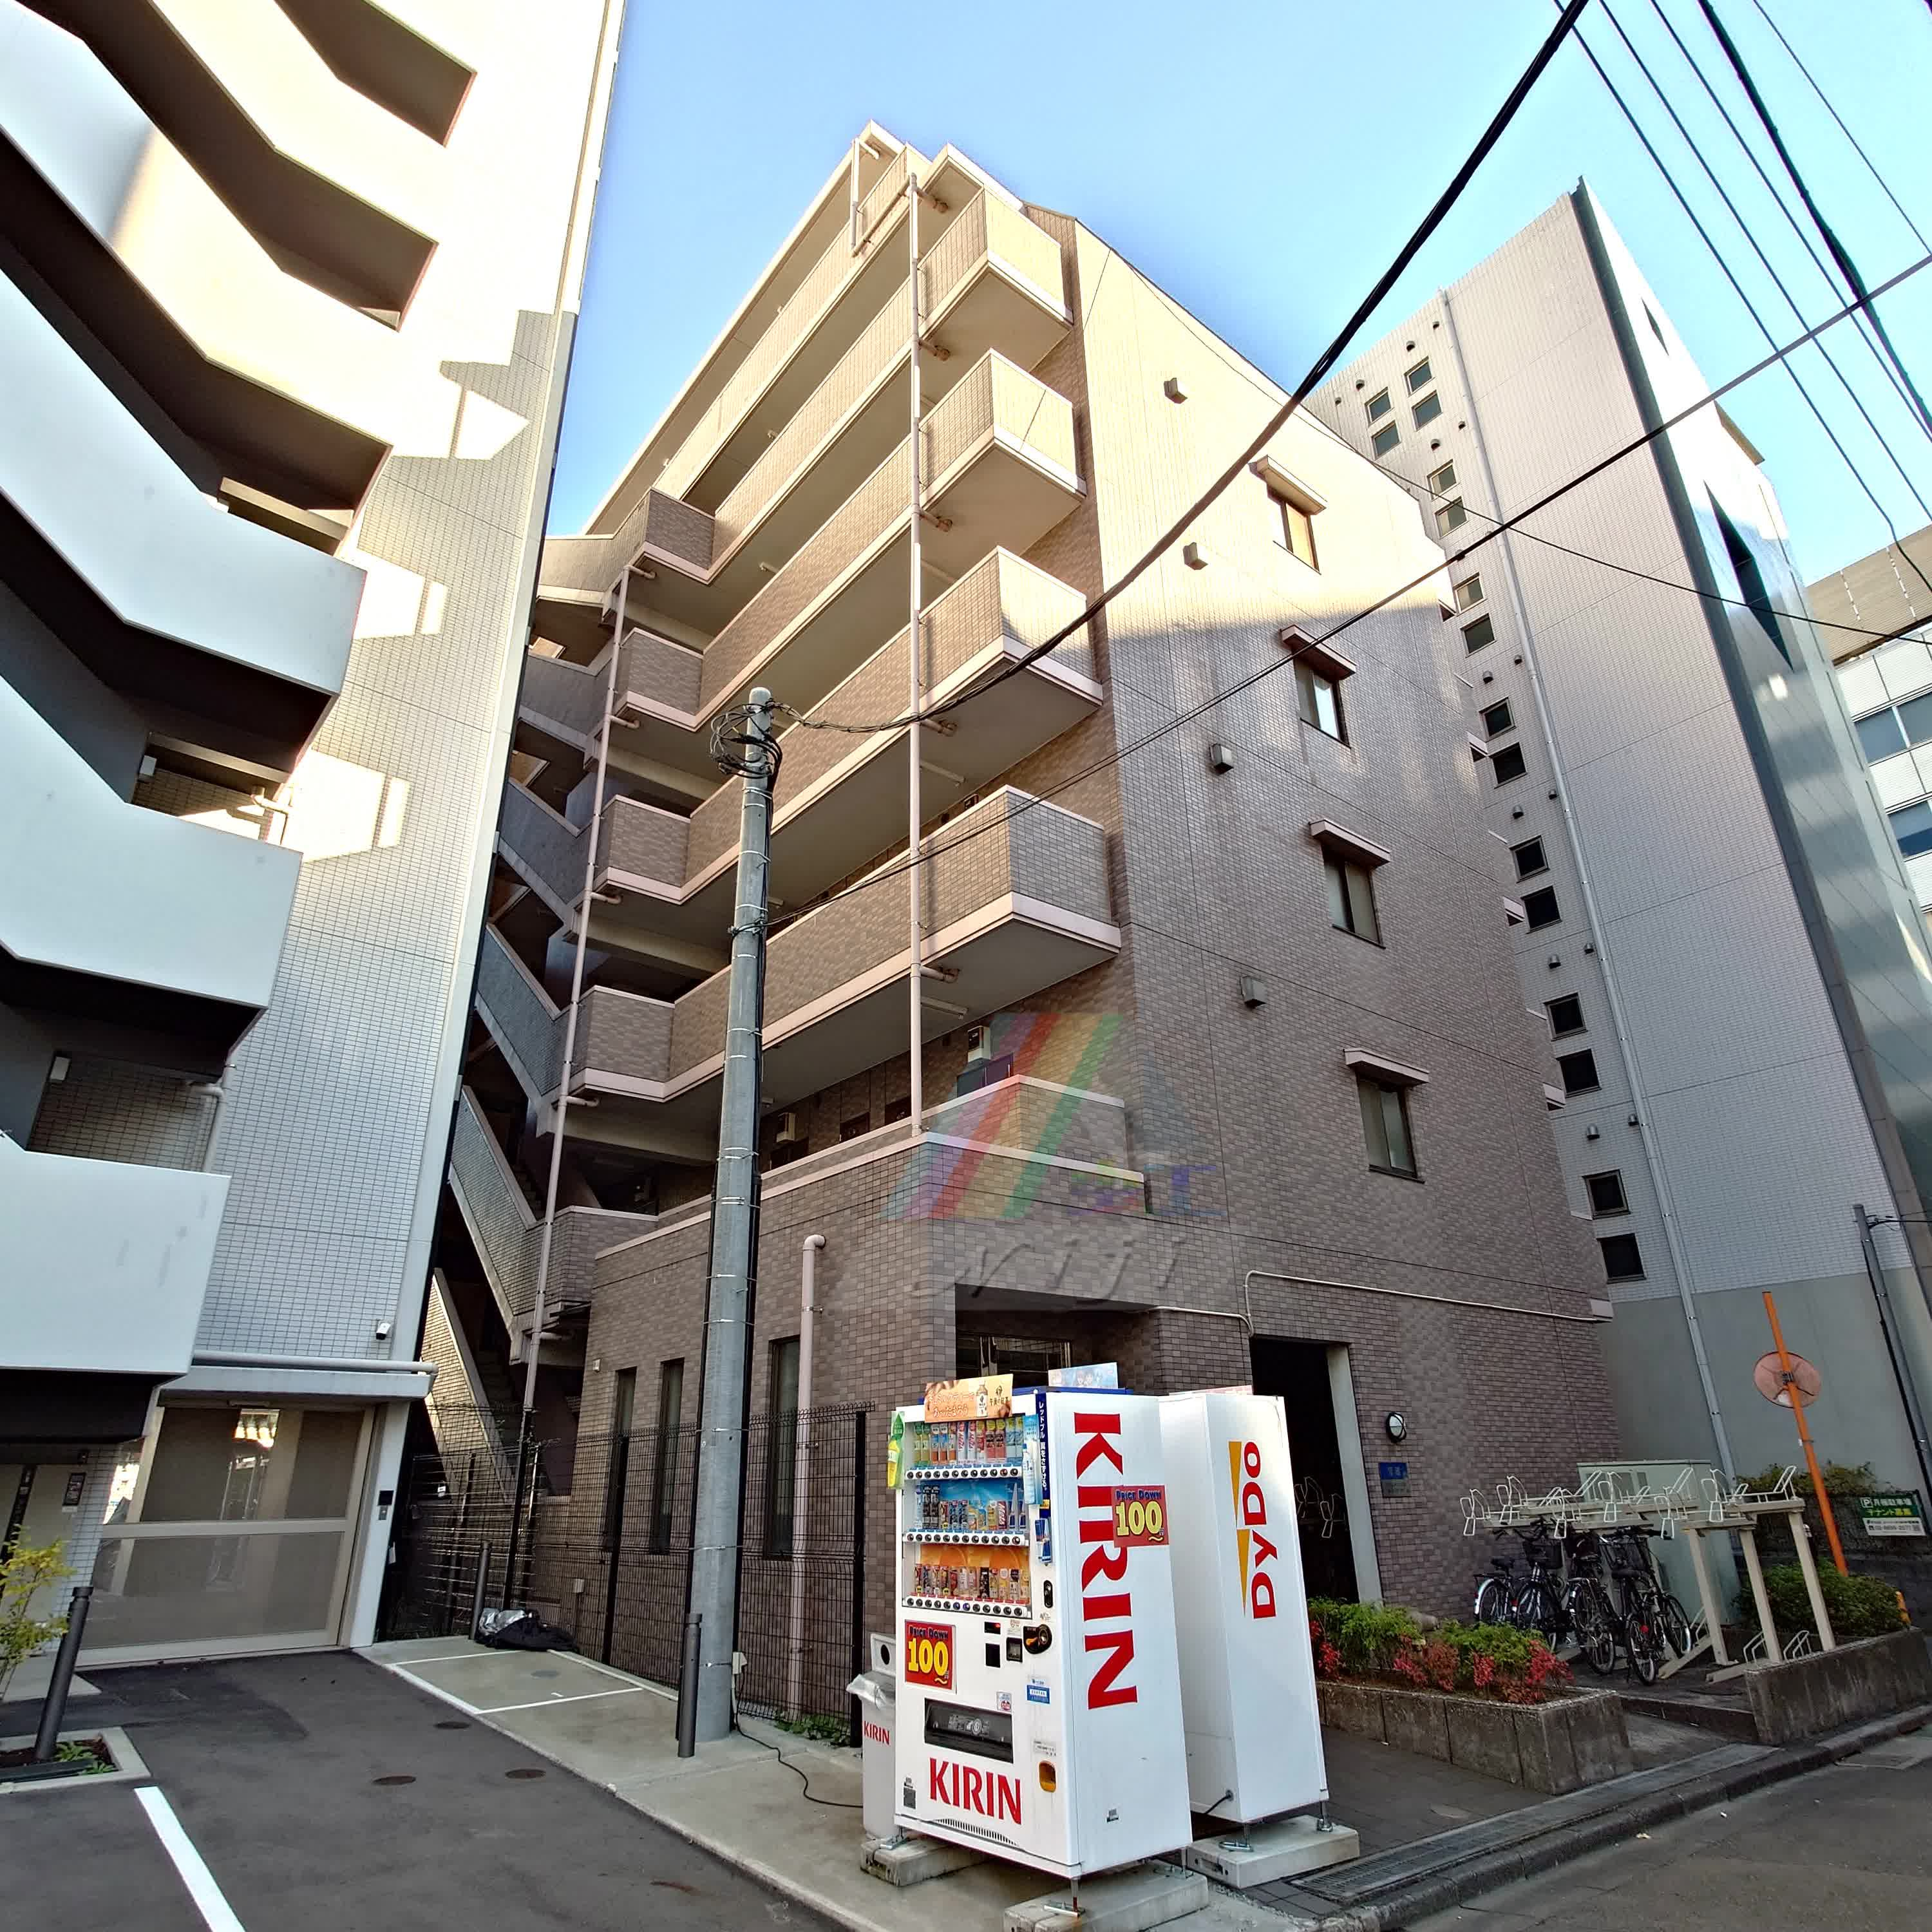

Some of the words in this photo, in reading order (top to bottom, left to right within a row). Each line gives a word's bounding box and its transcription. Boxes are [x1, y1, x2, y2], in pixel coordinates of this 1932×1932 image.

[1074, 1412, 1138, 1710] KIRIN
[864, 1720, 891, 1746] KIRIN
[930, 1757, 1022, 1826] KIRIN
